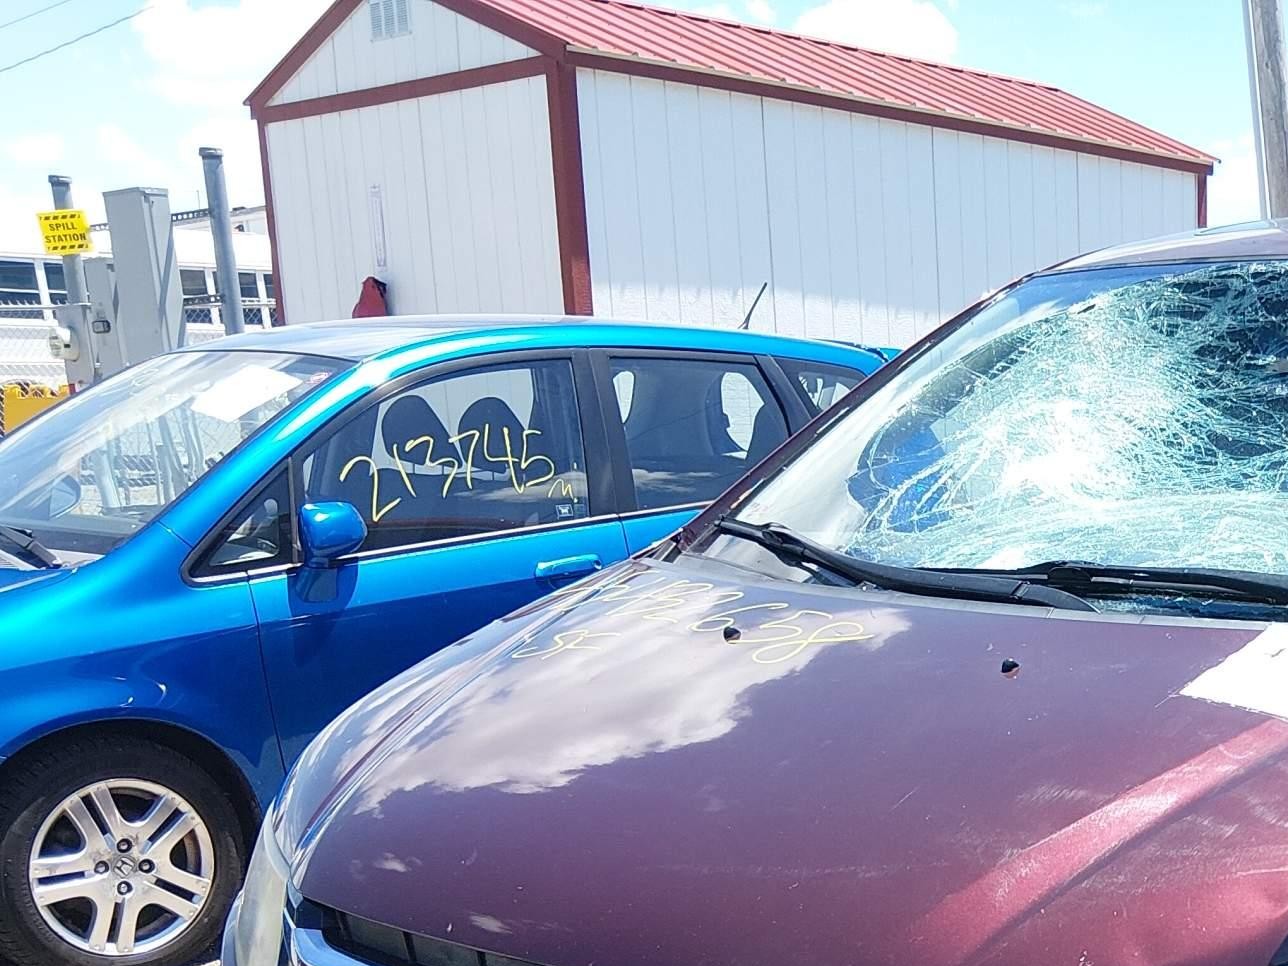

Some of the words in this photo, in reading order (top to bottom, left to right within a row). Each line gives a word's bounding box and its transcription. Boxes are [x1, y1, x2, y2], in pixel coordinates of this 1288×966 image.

[48, 222, 78, 231] SPILL
[44, 232, 87, 243] STATION
[340, 424, 554, 522] 213745
